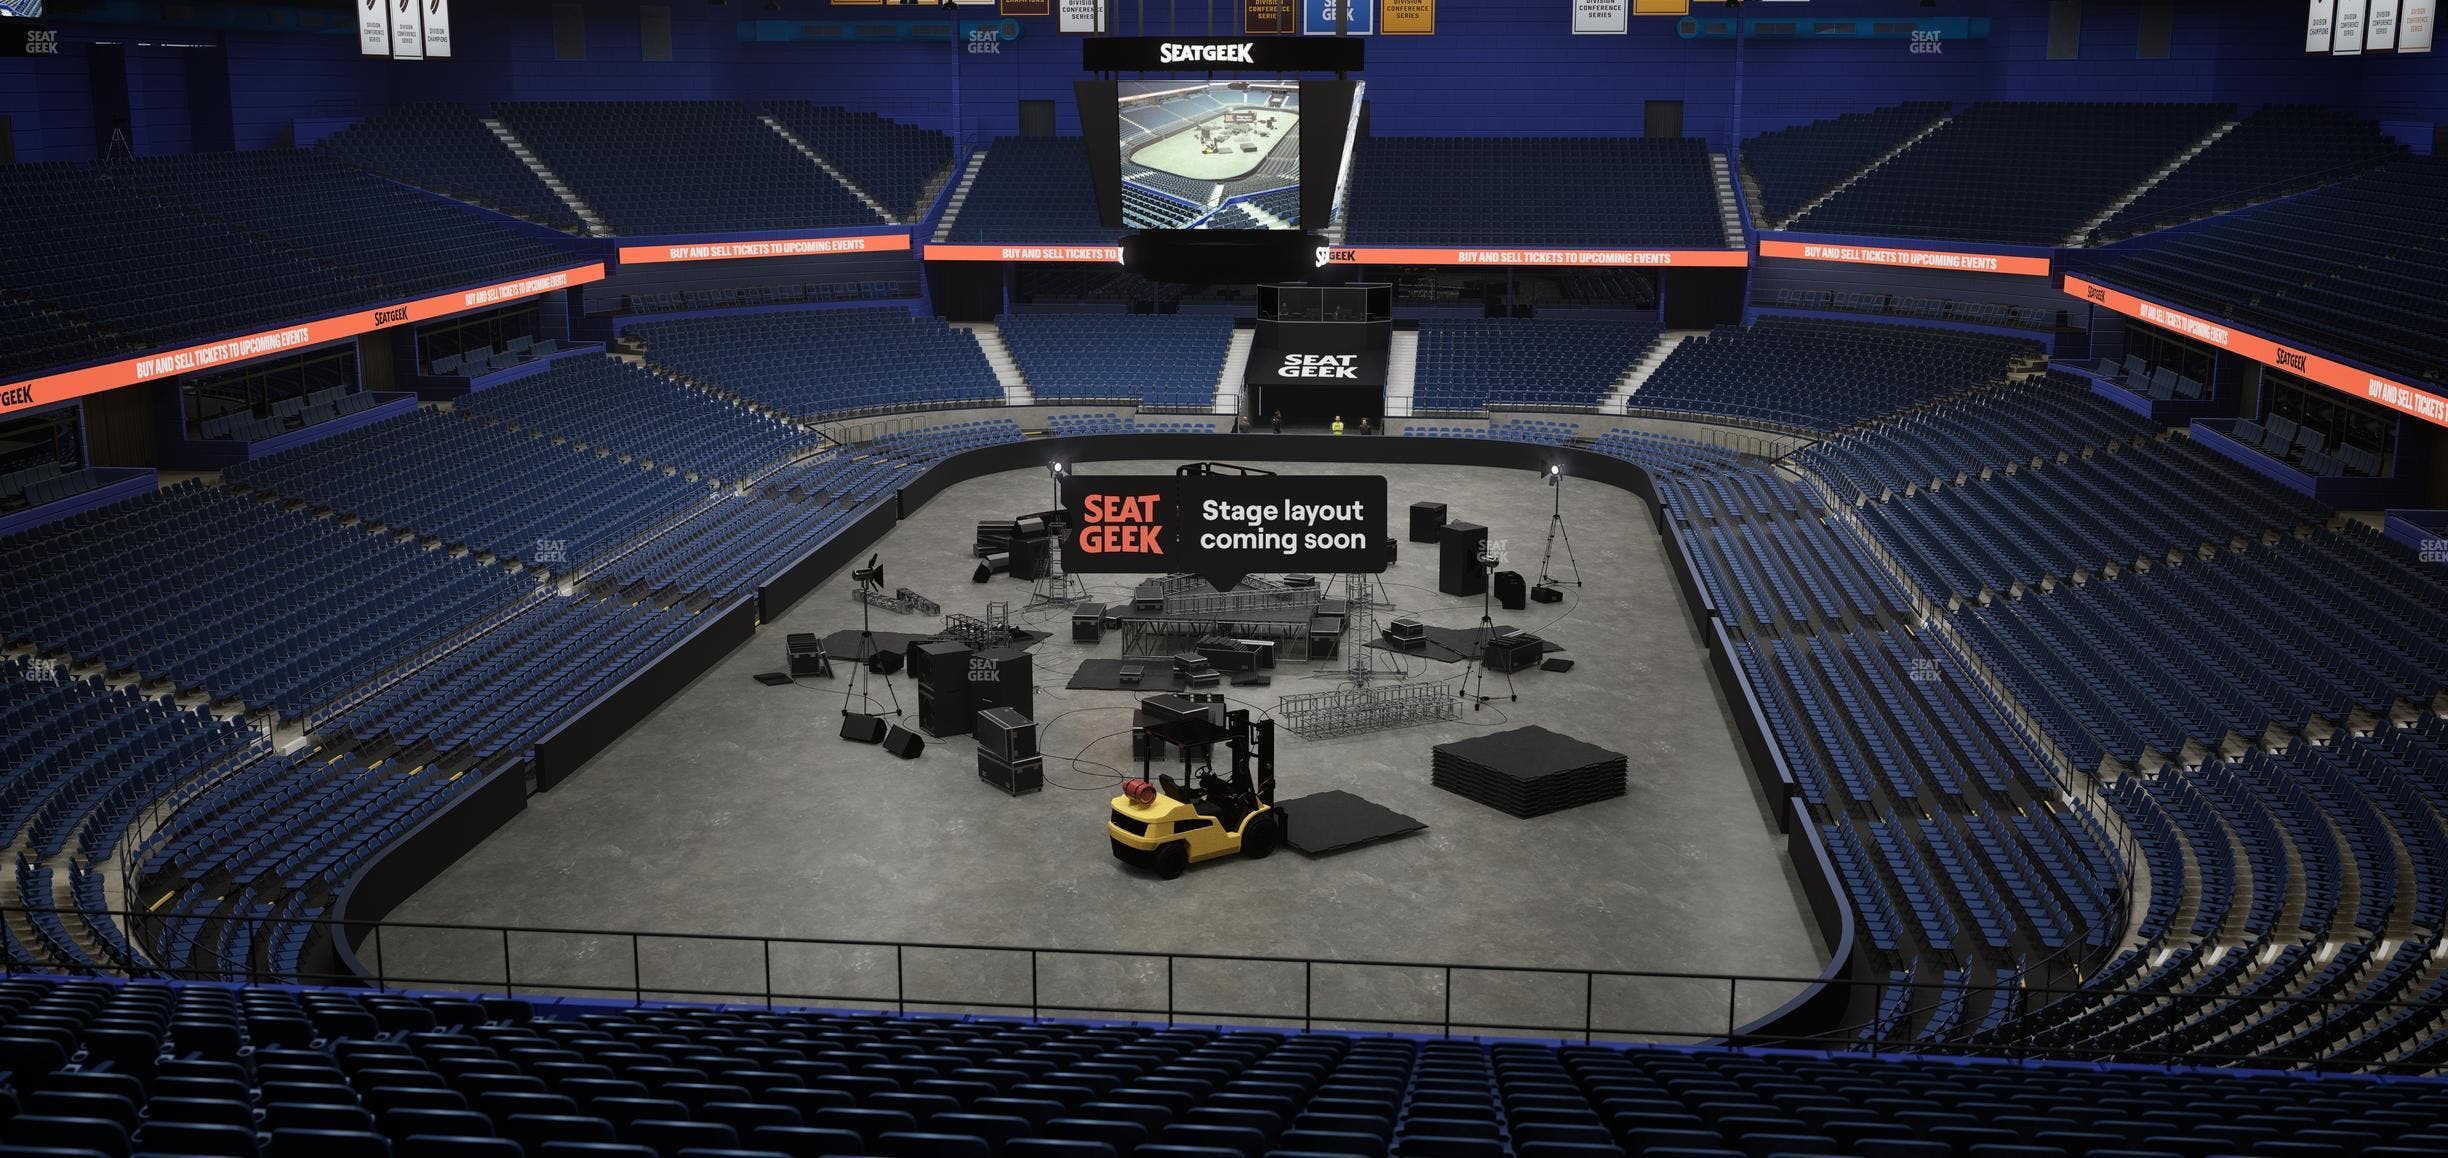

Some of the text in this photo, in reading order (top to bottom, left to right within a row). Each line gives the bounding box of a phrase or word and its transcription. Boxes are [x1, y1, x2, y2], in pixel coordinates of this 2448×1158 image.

[1322, 8, 1354, 21] GEK
[1160, 42, 1254, 64] SEATGEEK
[670, 240, 864, 258] BUY AND SELL TICKETS TO UPCOMING EVENTS
[1002, 248, 1020, 258] BUY
[1022, 248, 1041, 258] AND
[1042, 248, 1064, 258] SELL
[1065, 249, 1102, 259] TICKETS
[1104, 249, 1116, 259] TO
[1458, 252, 1672, 264] BUY AND SELL TICKETS TO UPCOMING EVENTS
[1804, 246, 1997, 270] BUY AND SELL TICKETS TO UPCOMING EVENTS
[374, 306, 408, 326] SEATGEEK
[136, 328, 308, 378] BUY AND SELL TICKETS TO UPCOMING EVENTS
[1284, 354, 1358, 366] SEAT
[2276, 347, 2306, 374] SEATGEEK
[1278, 366, 1358, 378] GEEK
[0, 384, 34, 406] GEEK
[2368, 378, 2383, 398] BUY
[2382, 383, 2397, 404] AND
[2398, 388, 2414, 410] SELL
[2414, 393, 2444, 420] TICKETS
[1084, 494, 1160, 522] SEAT
[1202, 499, 1364, 526] Stage layout
[1079, 526, 1164, 555] GEEK
[1200, 528, 1366, 555] coming soon
